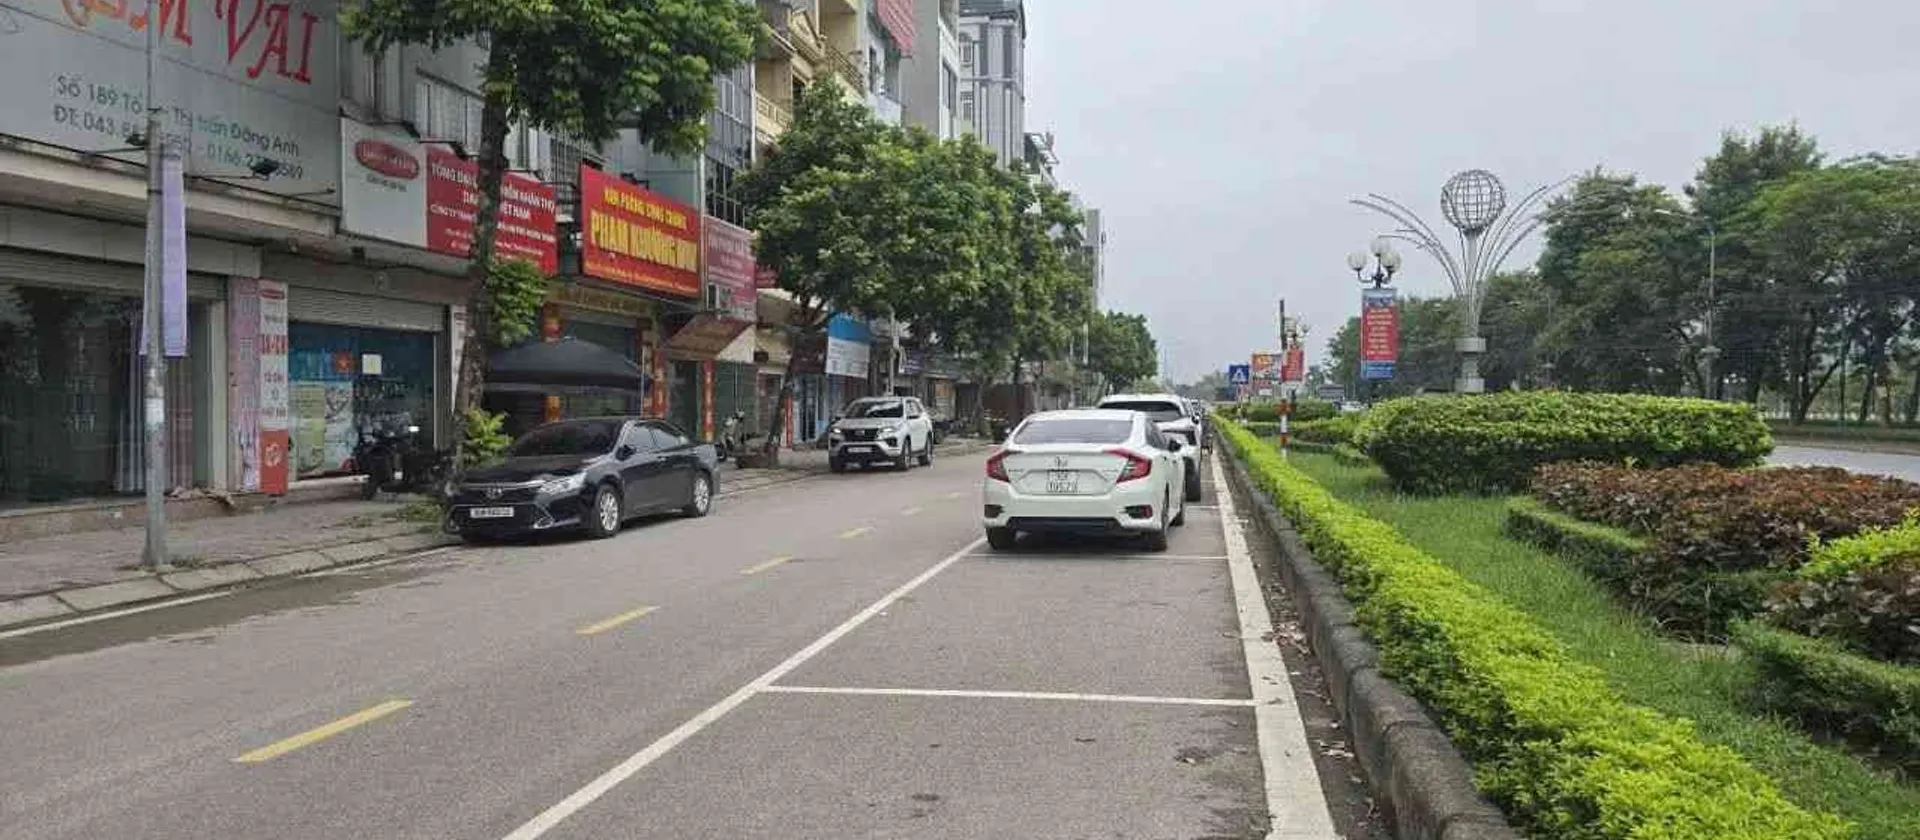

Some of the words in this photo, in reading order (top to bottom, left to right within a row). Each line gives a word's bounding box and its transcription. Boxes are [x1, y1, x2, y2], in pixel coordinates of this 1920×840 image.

[57, 73, 82, 98] Số
[88, 83, 119, 106] 189
[271, 134, 300, 158] Anh
